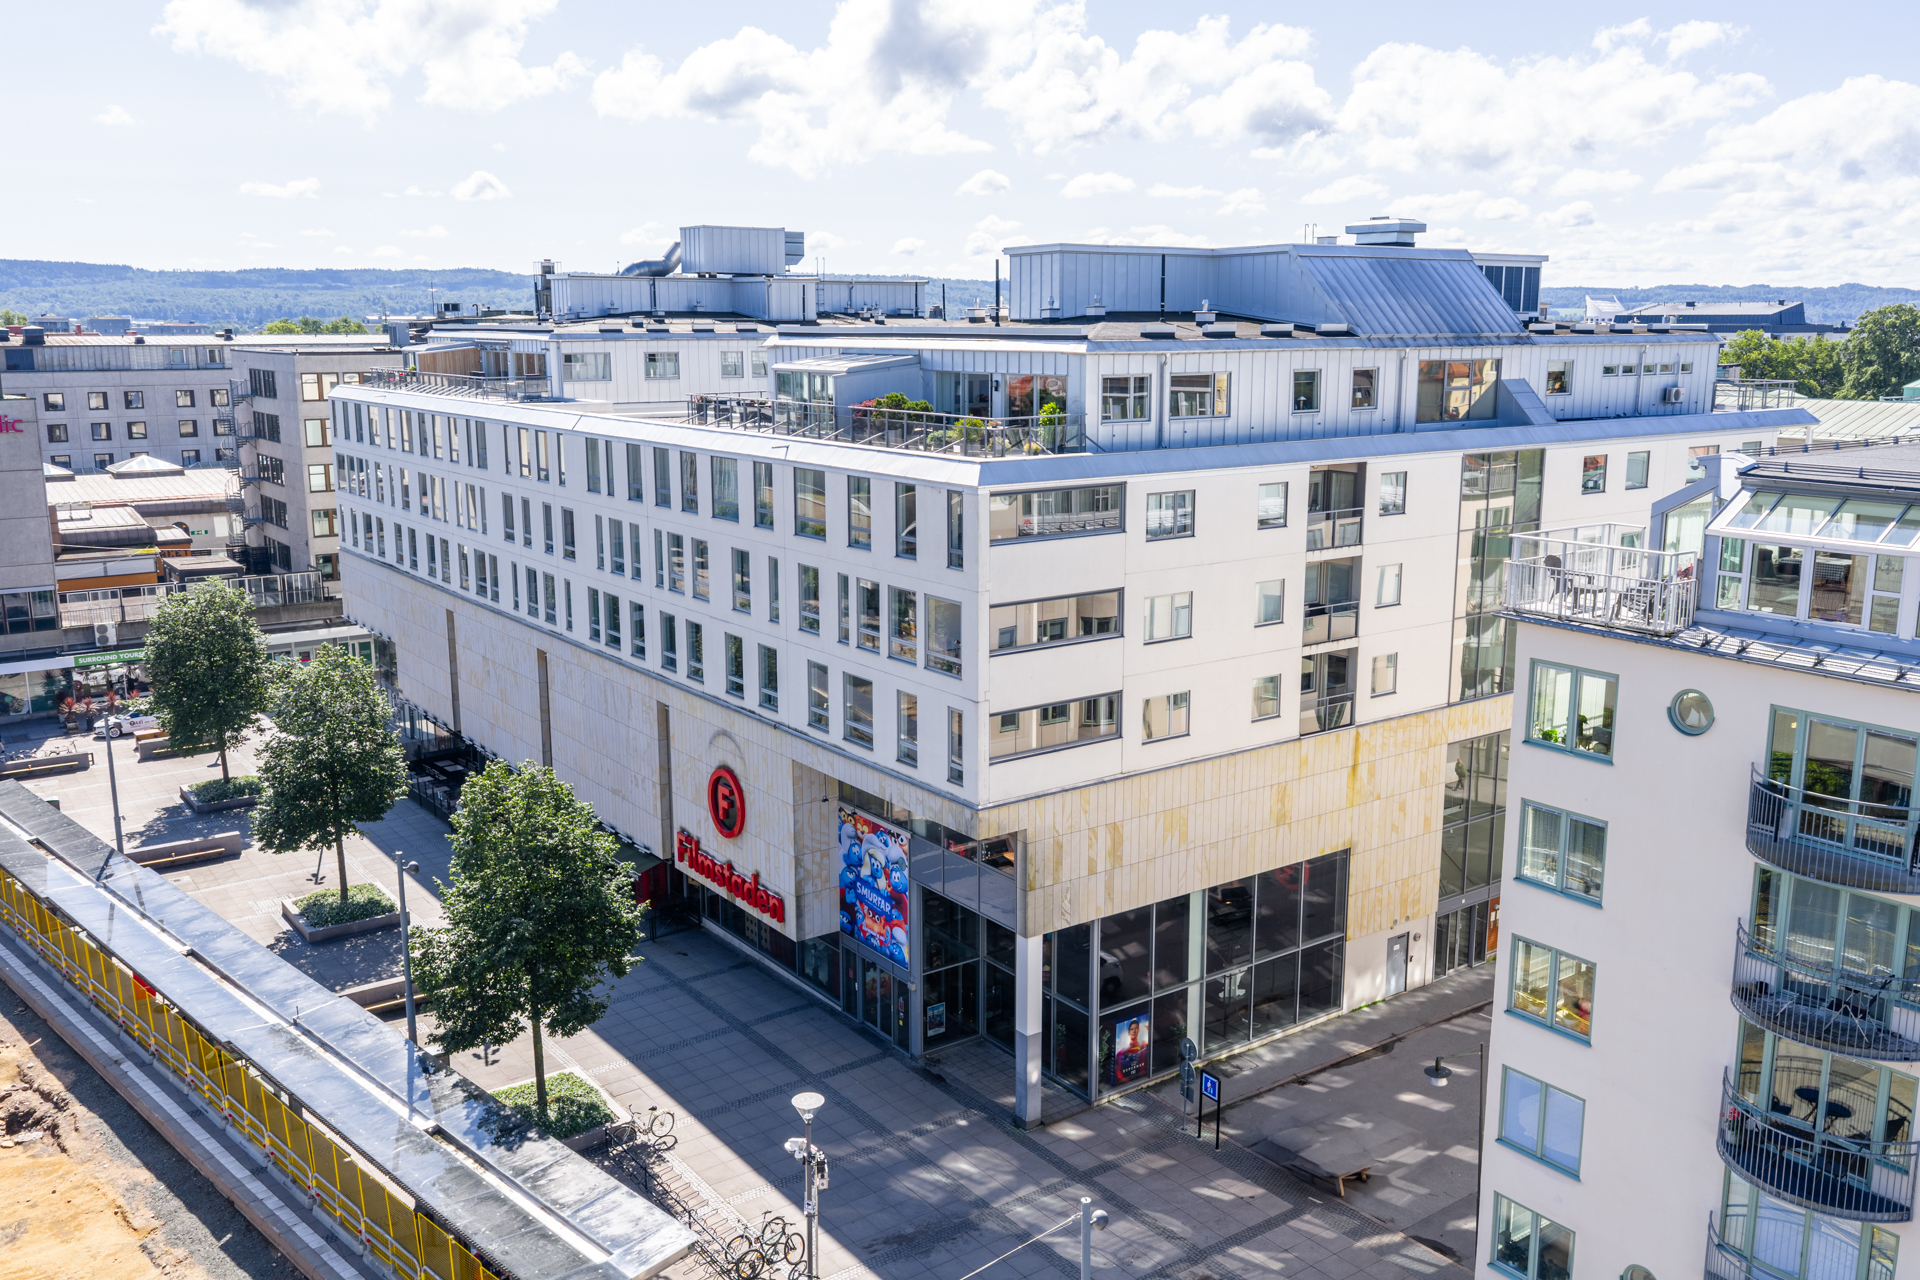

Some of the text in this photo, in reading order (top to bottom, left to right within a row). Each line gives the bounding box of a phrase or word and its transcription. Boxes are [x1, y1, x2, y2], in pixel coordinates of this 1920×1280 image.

[78, 654, 118, 664] SURROUND
[676, 831, 785, 924] Filmstaden
[856, 881, 891, 915] SMURFAR
